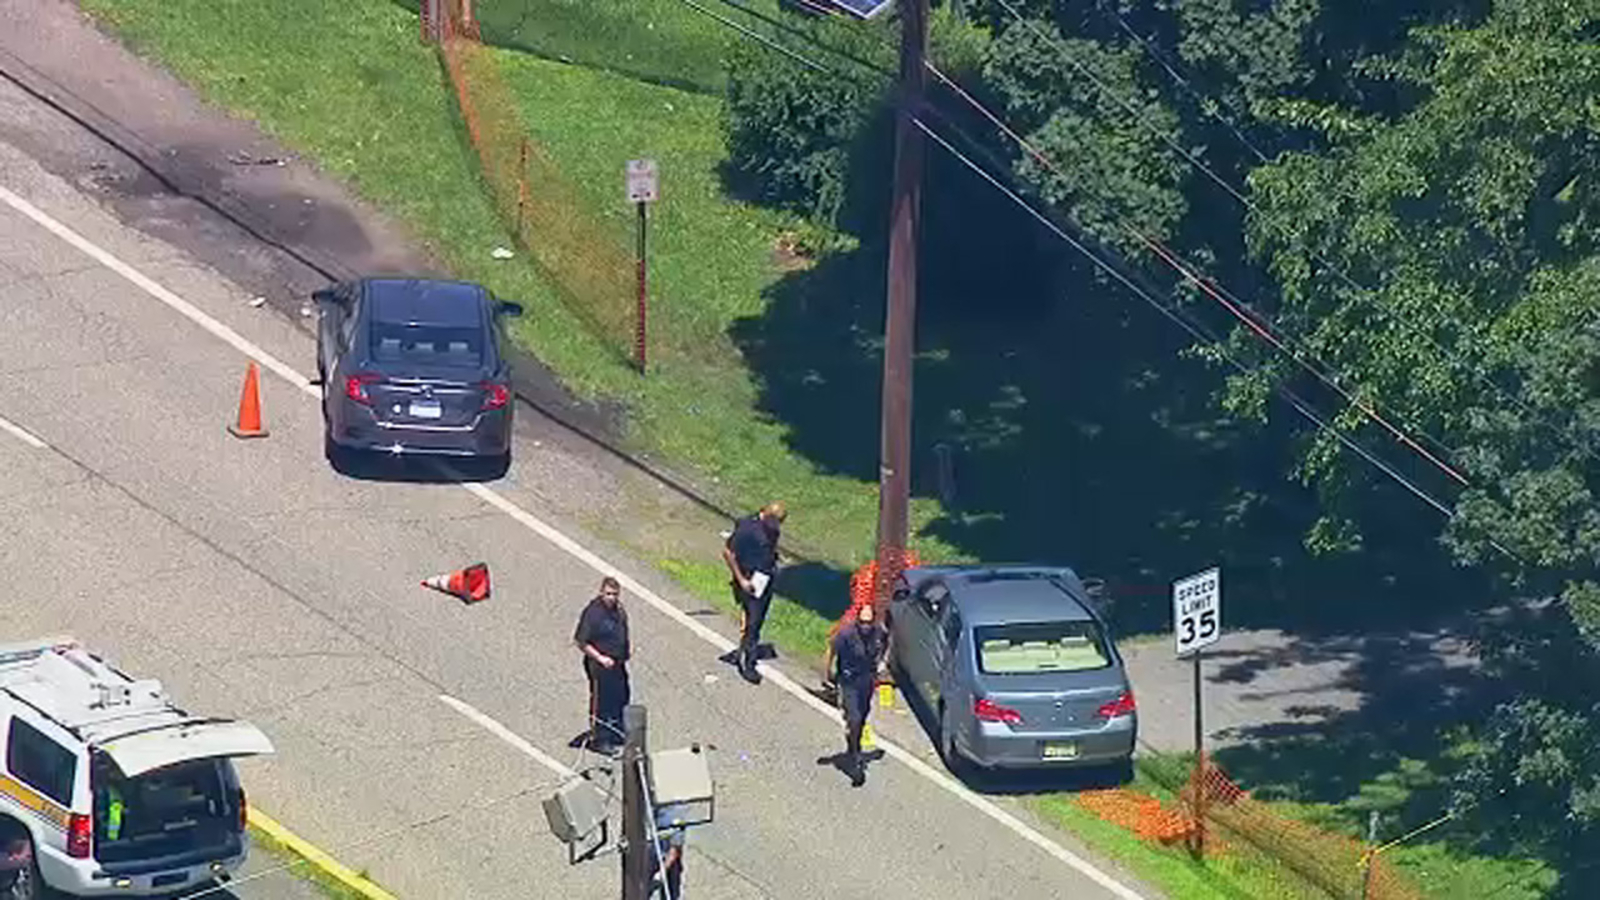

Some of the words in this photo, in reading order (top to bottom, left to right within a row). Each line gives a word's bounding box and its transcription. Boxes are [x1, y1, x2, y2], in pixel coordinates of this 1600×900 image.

[1179, 580, 1215, 601] SPEED
[1182, 595, 1211, 615] LIMIT
[1180, 609, 1215, 644] 35
